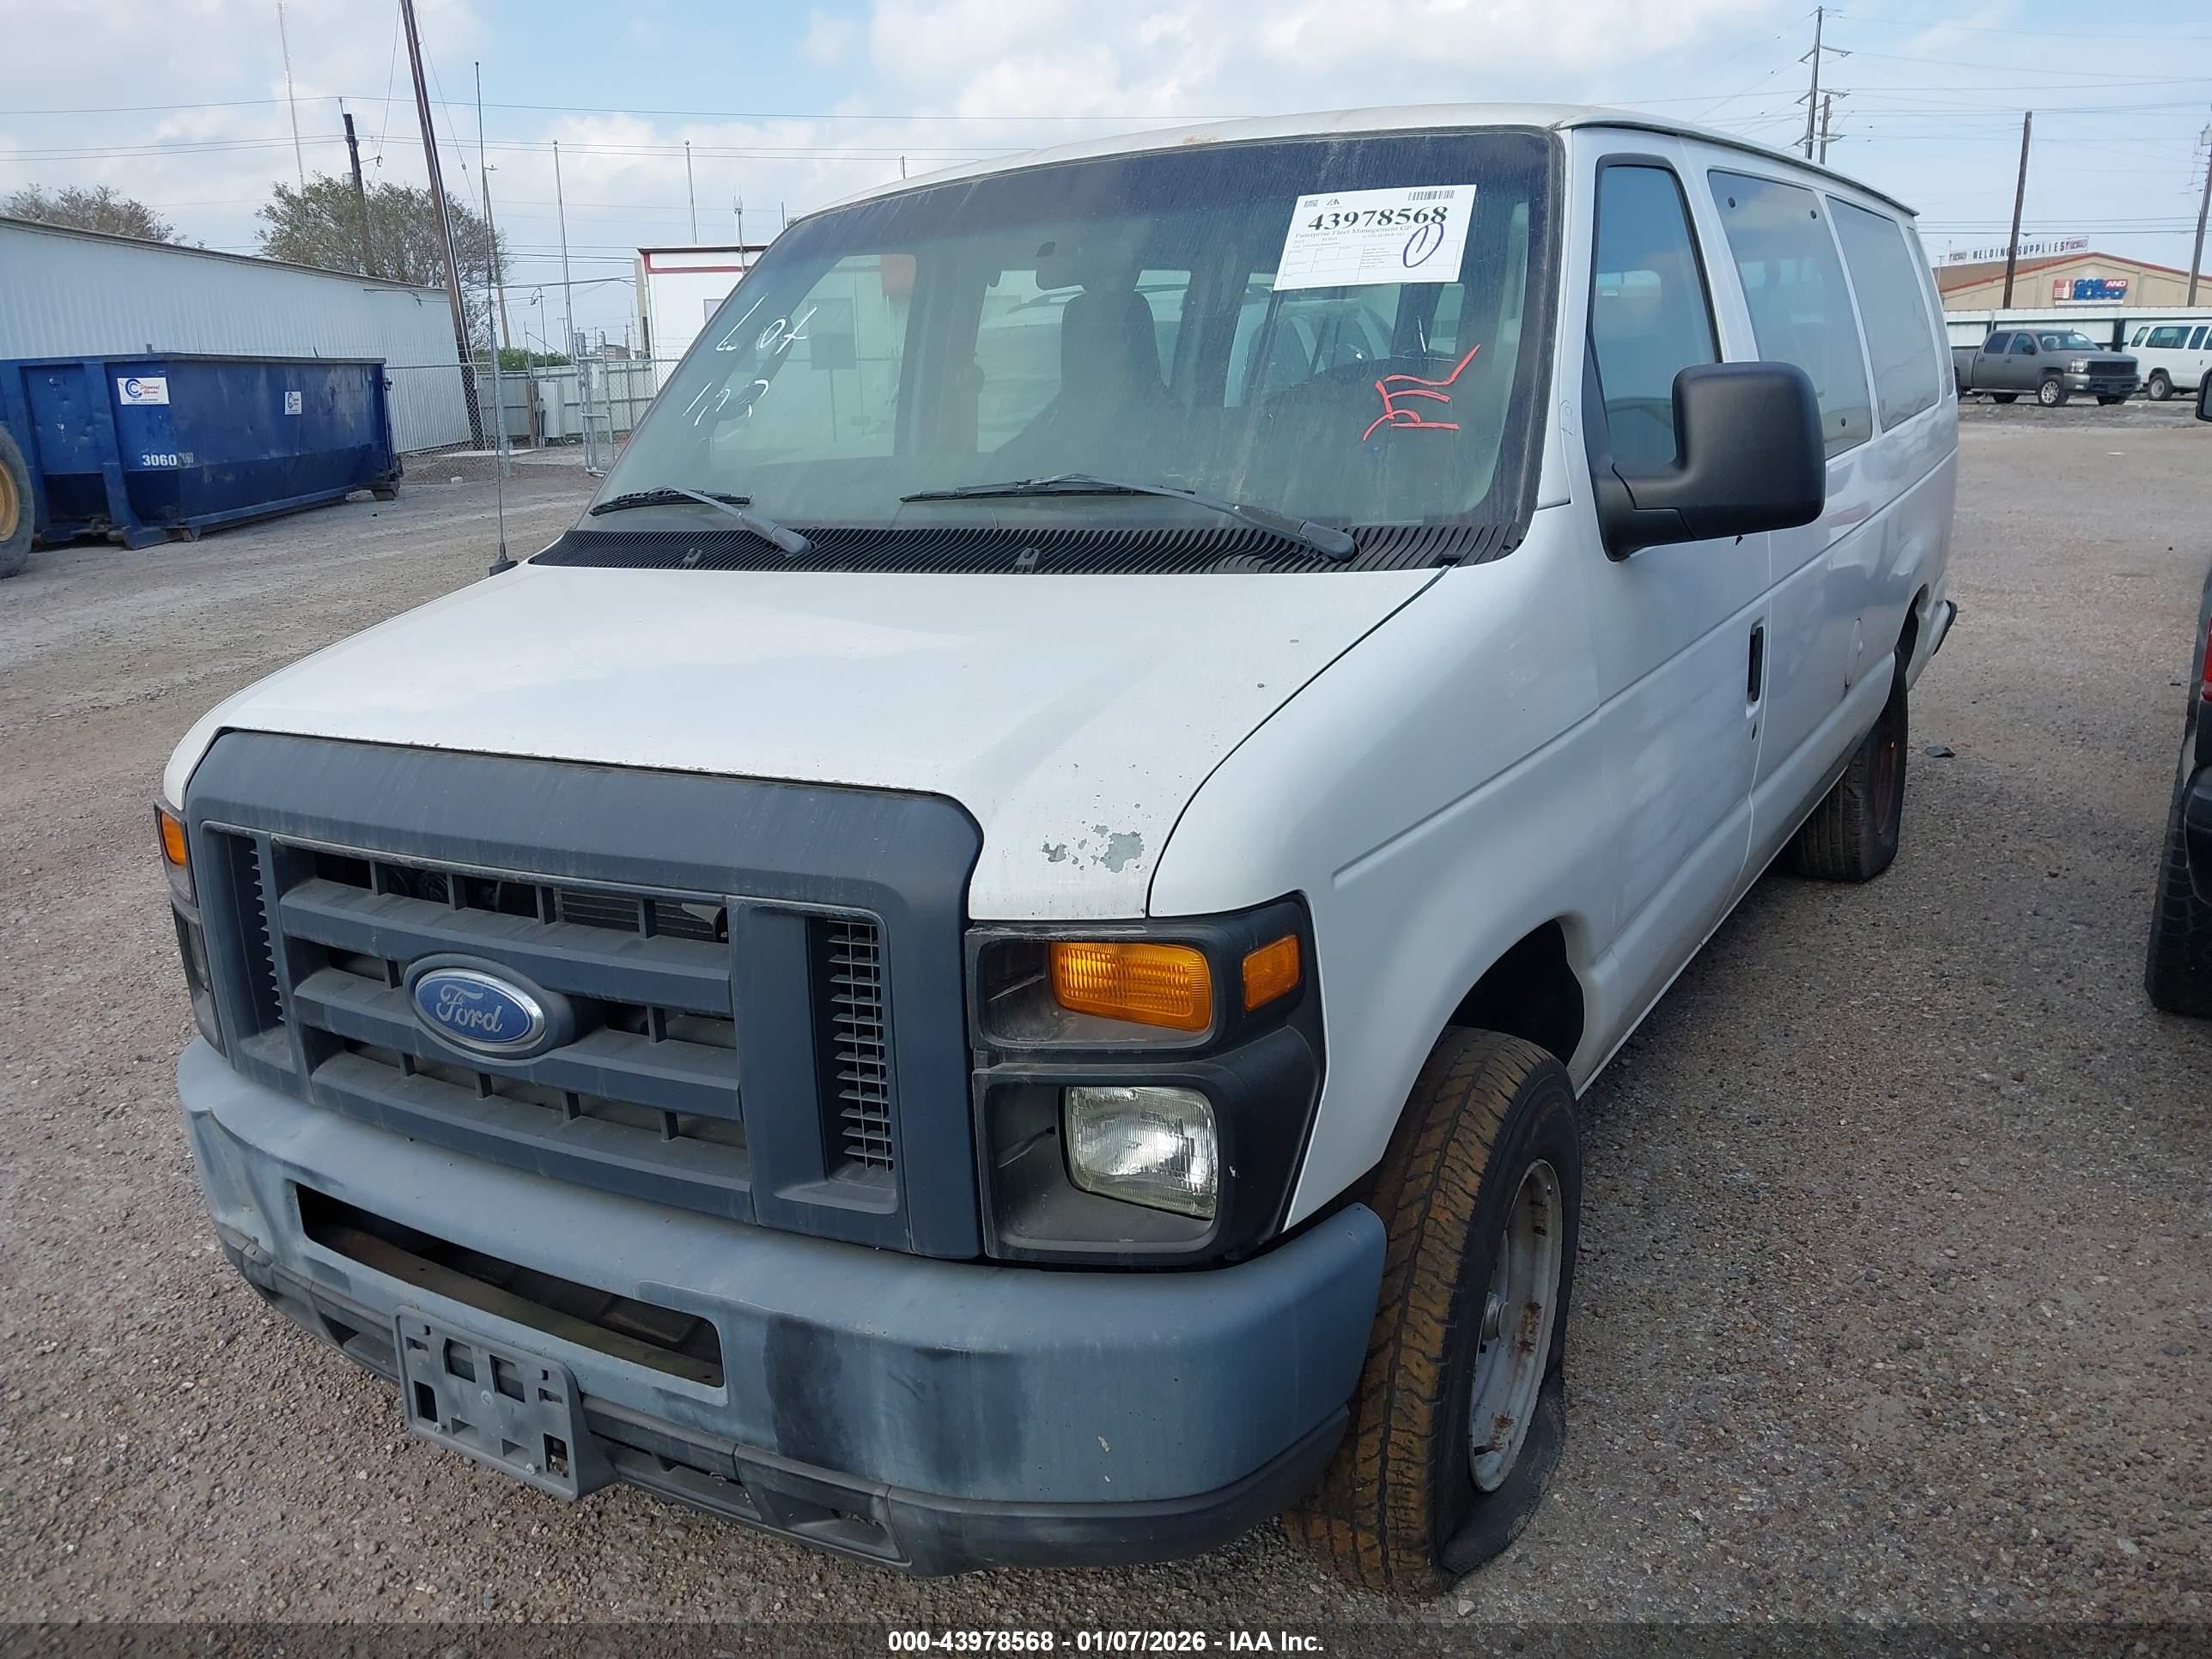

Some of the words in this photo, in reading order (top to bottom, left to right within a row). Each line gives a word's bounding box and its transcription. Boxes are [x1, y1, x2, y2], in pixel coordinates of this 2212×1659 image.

[1308, 205, 1449, 231] 43978568
[2018, 241, 2064, 256] SUPPLIES
[142, 453, 178, 466] 3060
[436, 983, 503, 1033] Ford
